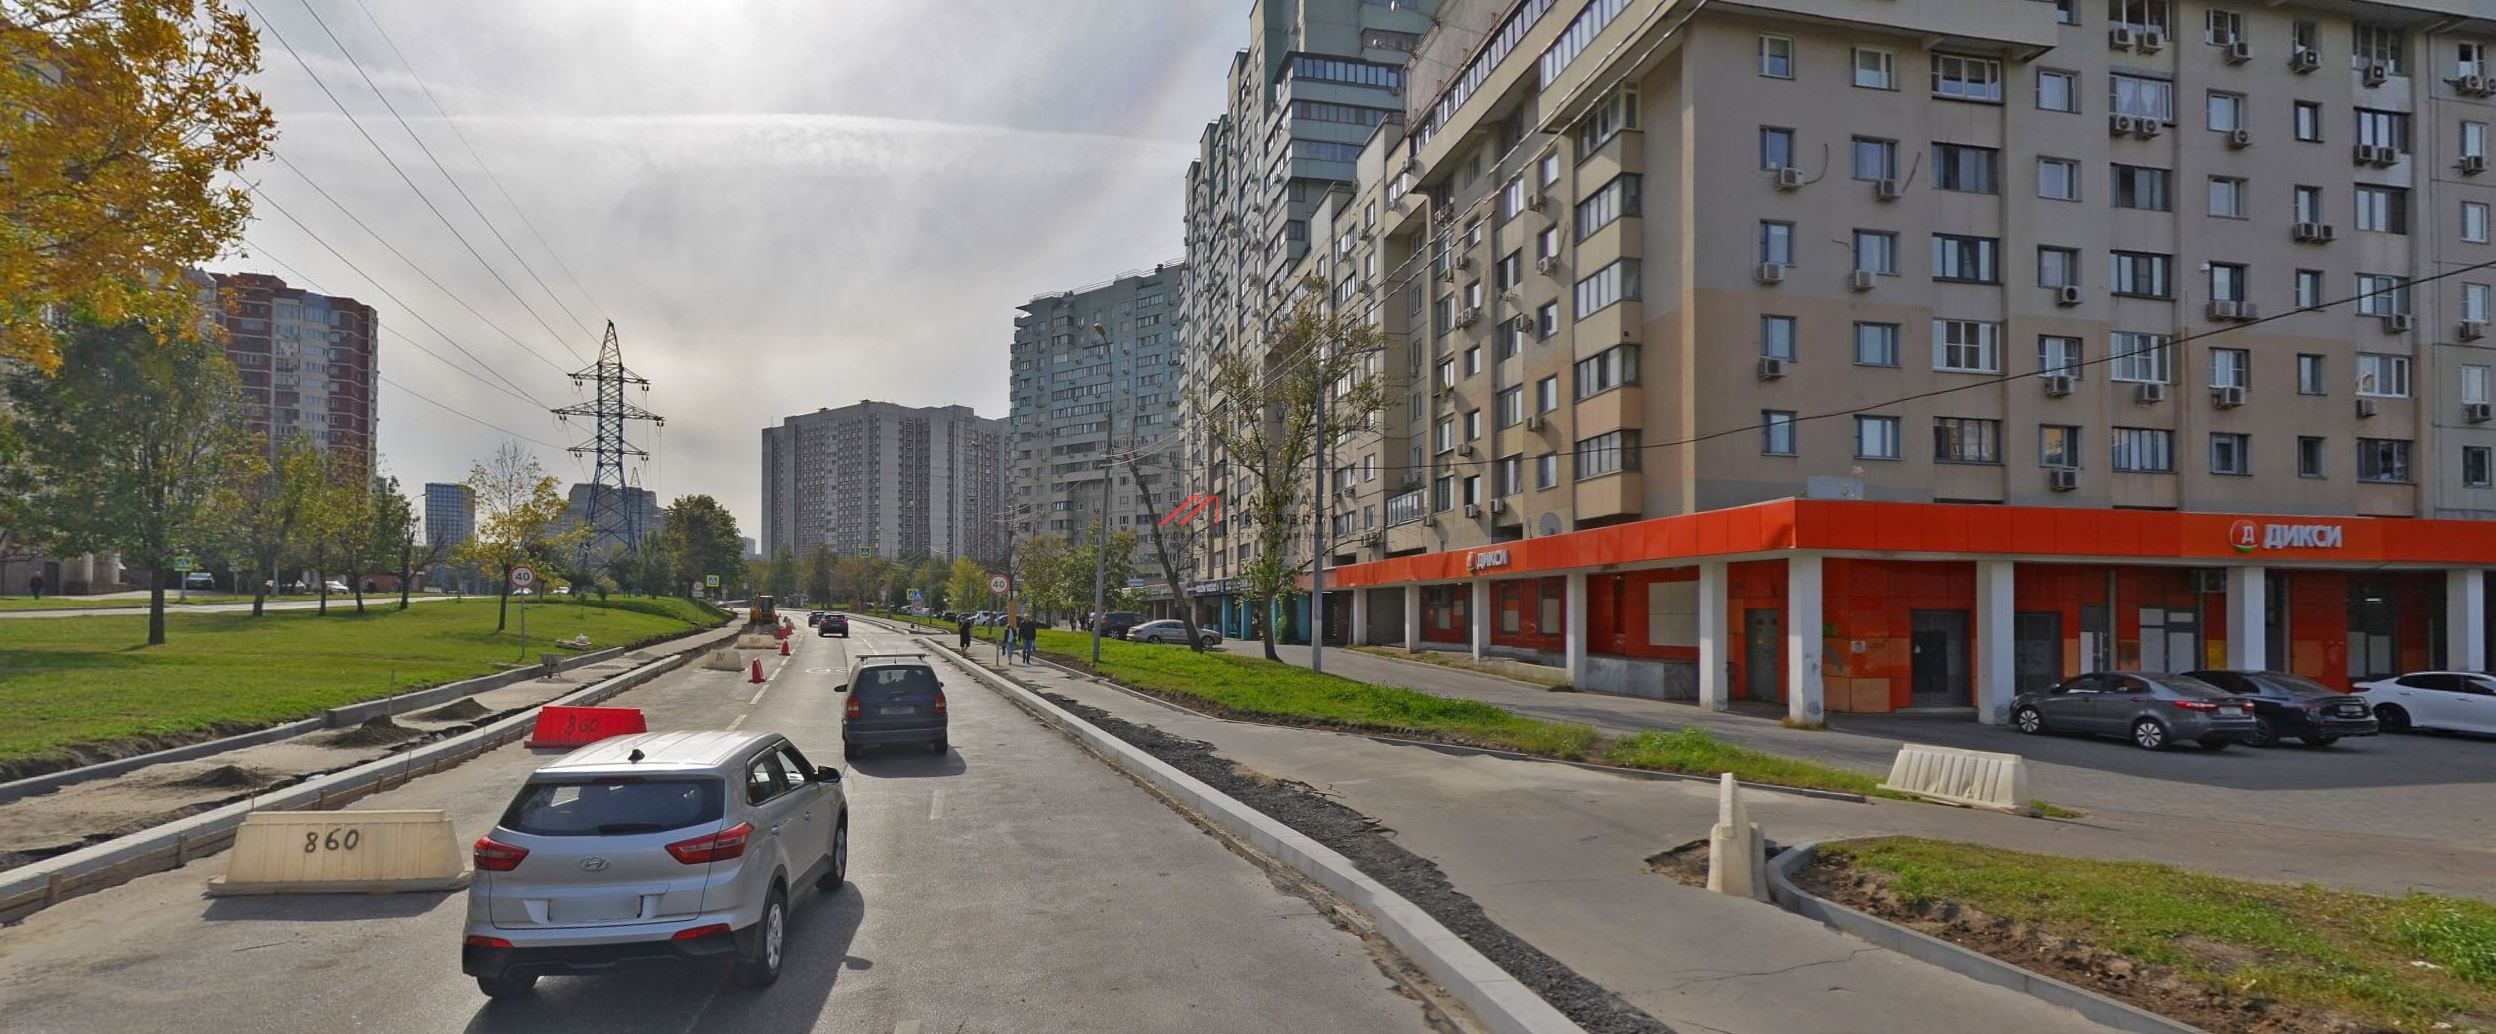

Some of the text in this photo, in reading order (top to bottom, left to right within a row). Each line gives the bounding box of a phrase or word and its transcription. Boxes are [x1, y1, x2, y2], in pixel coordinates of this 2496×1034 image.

[2263, 524, 2342, 549] ДИКСИ
[1476, 549, 1509, 569] ДИКСИ
[515, 572, 530, 581] 40
[992, 580, 1006, 589] 40
[305, 828, 359, 853] 860
